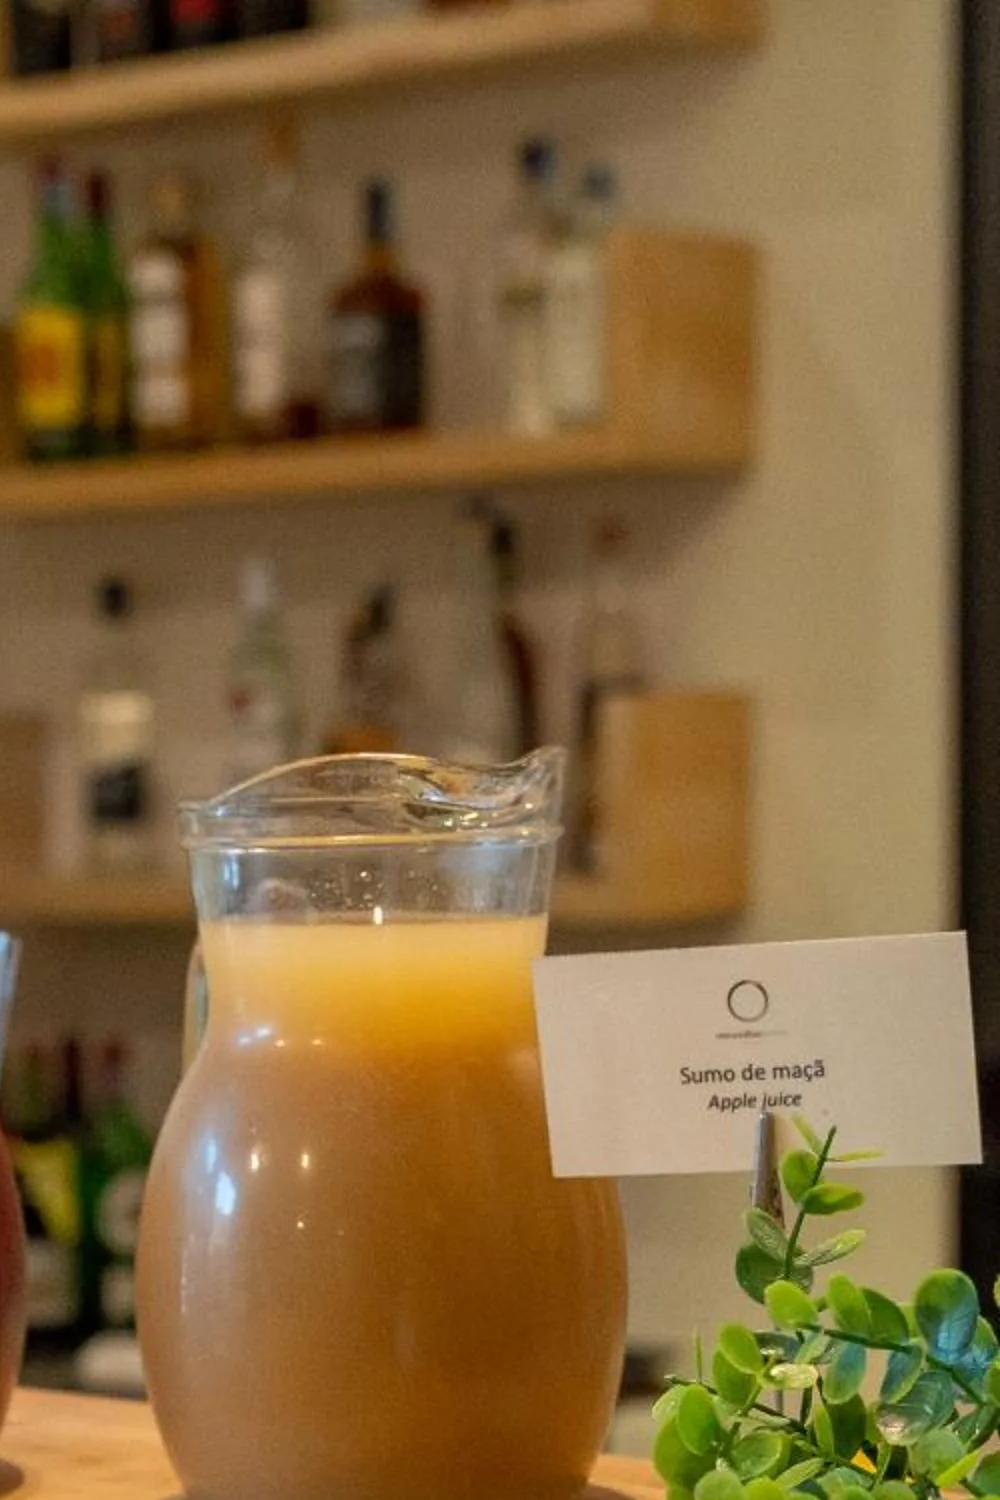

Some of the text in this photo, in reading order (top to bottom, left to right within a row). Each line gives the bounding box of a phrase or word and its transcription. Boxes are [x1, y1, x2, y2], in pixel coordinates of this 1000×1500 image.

[679, 1059, 825, 1085] Sumo de maçã
[707, 1092, 803, 1112] Apple juice
